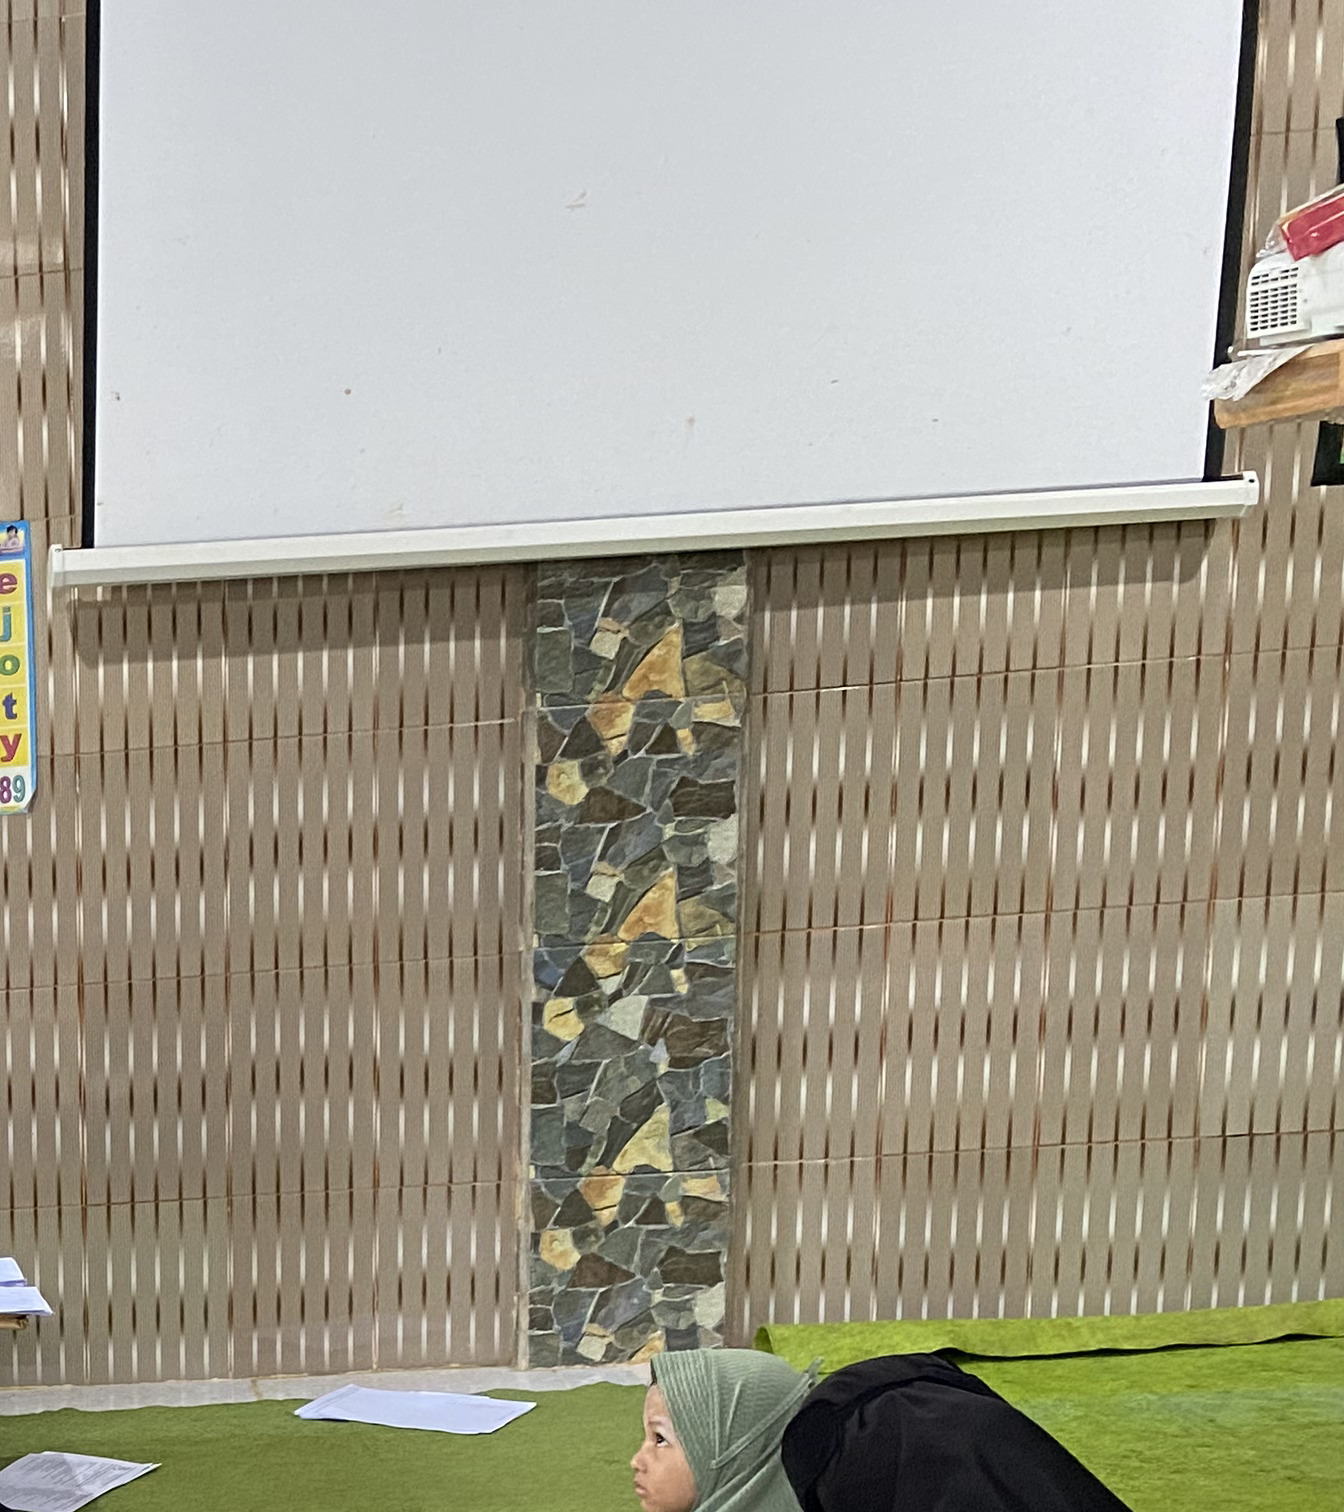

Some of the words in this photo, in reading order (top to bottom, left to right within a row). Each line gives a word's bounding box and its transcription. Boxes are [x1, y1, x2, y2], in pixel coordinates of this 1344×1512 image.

[0, 606, 12, 642] j
[2, 692, 18, 720] t
[0, 733, 23, 762] y
